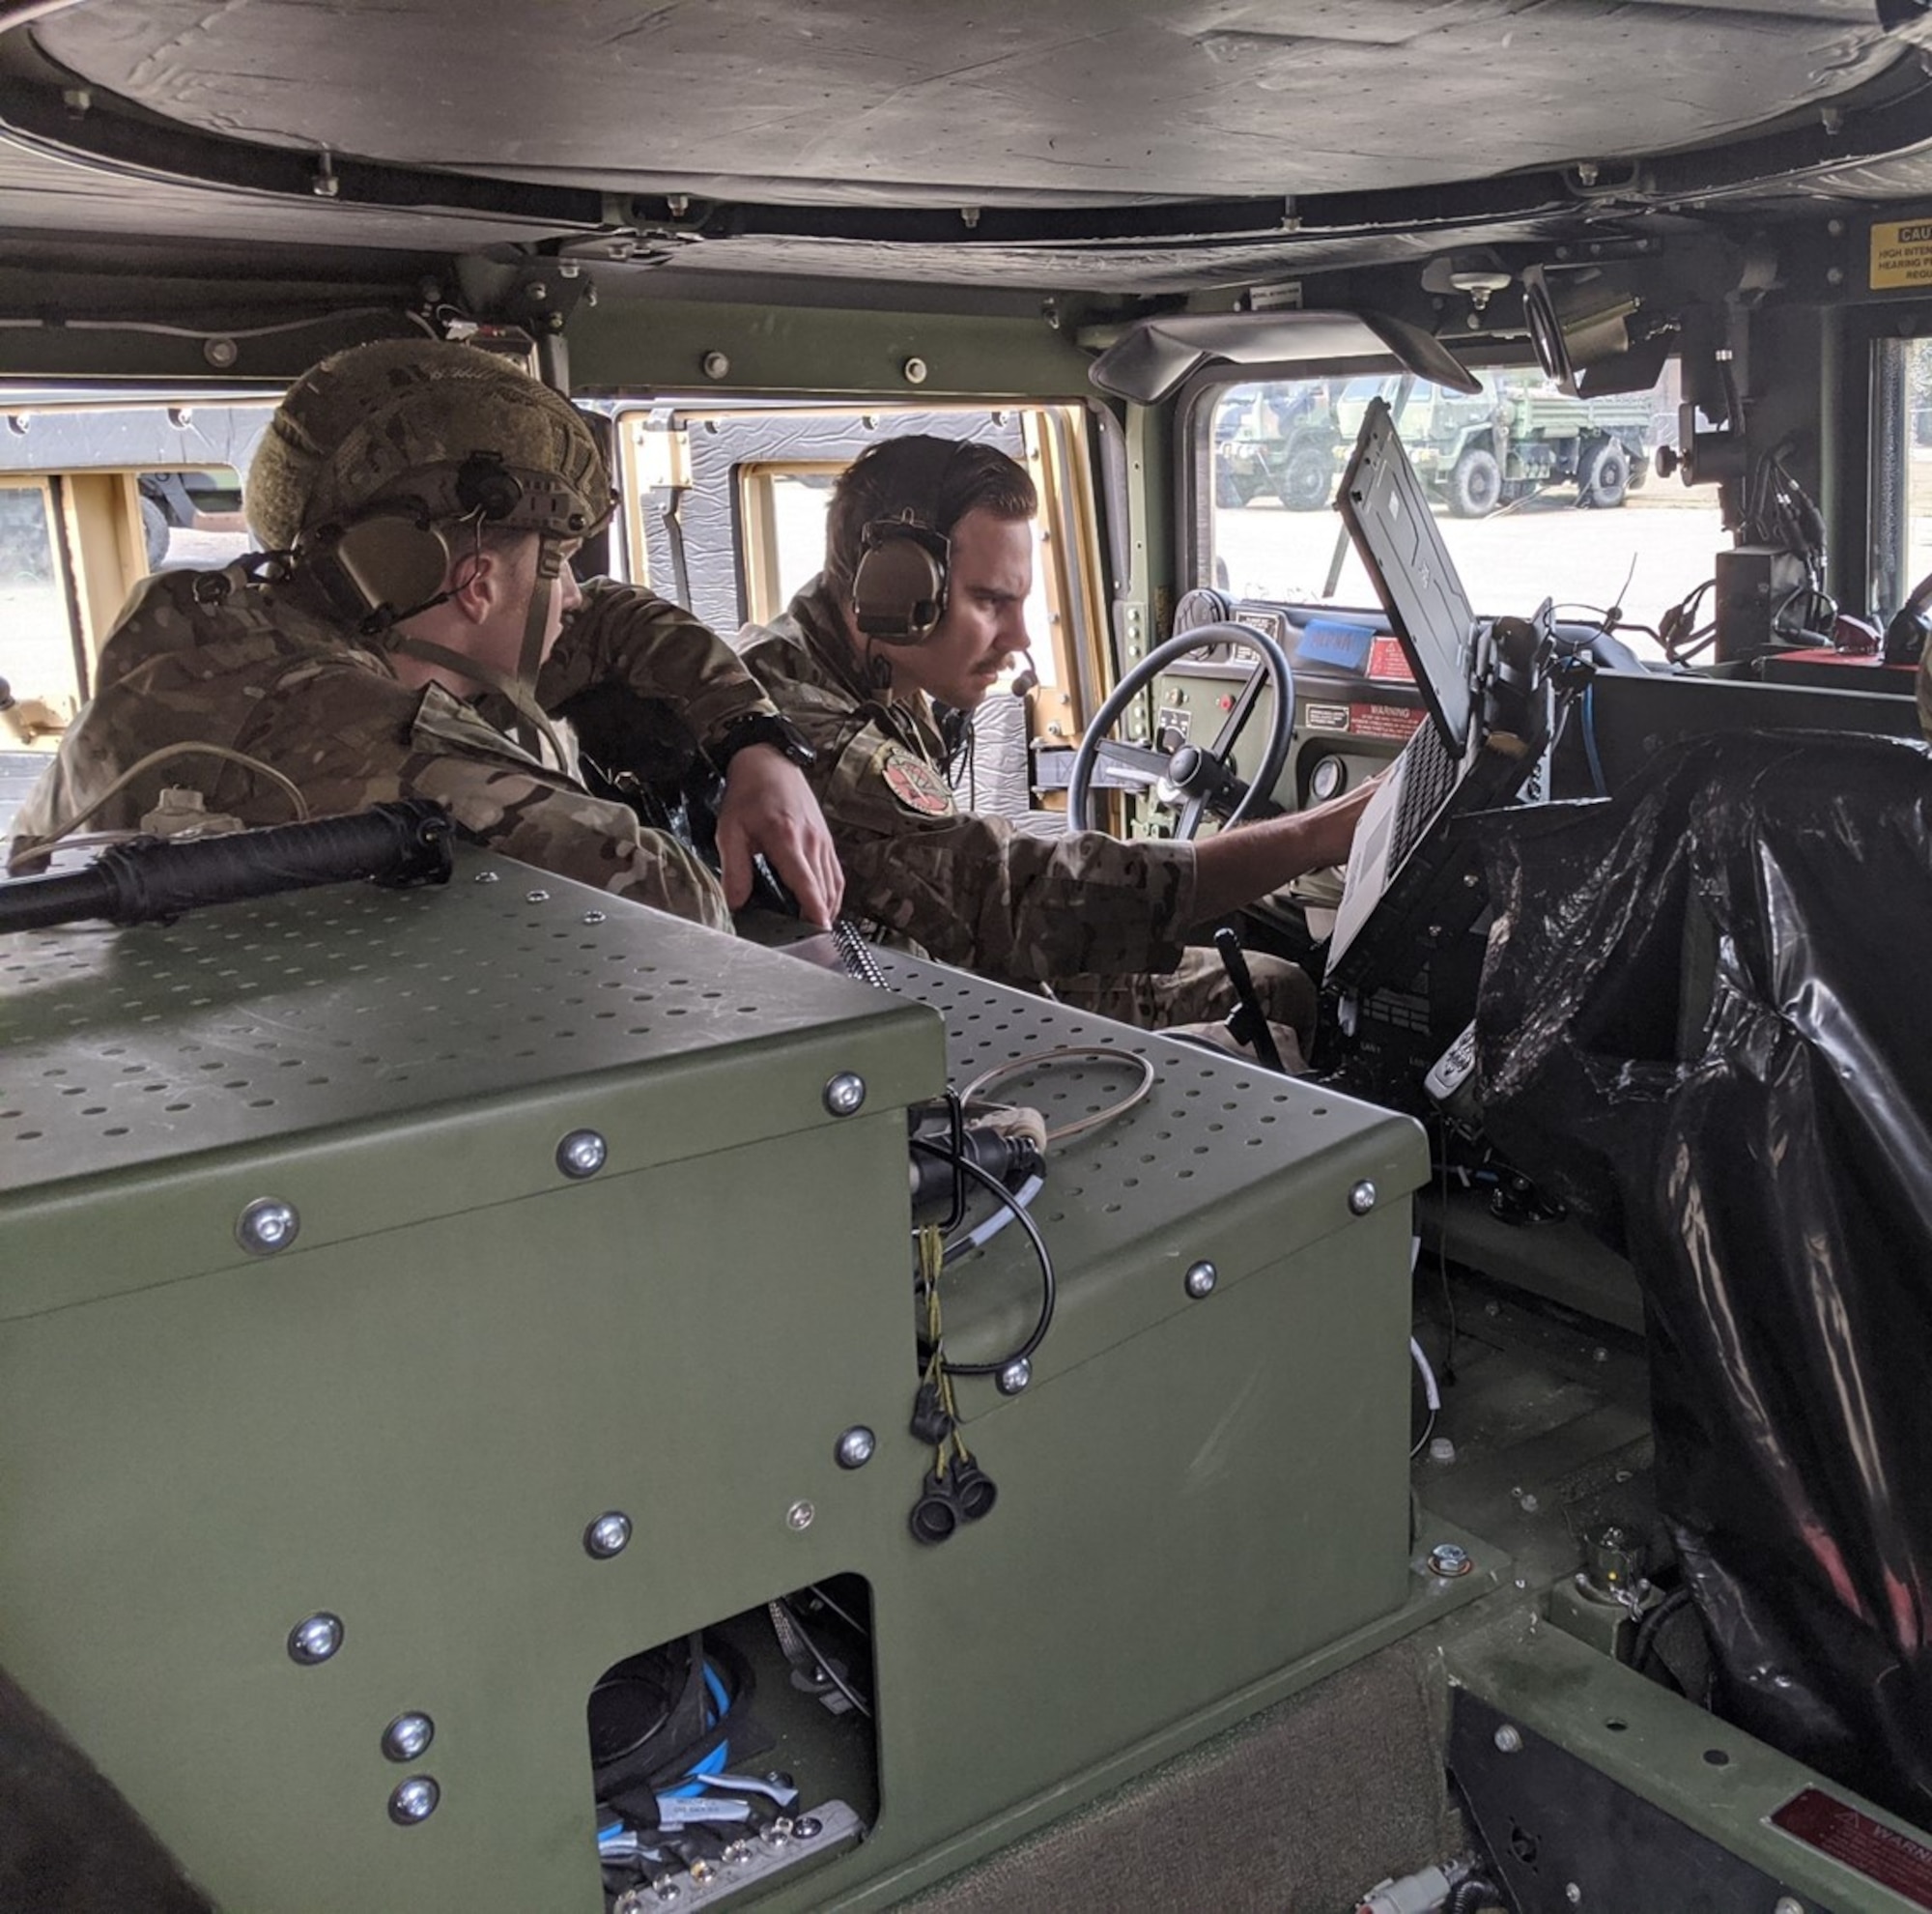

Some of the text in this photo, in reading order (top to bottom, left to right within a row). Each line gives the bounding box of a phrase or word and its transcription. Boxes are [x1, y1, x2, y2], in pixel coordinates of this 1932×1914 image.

[1901, 227, 1932, 242] CAU
[1879, 248, 1902, 259] HIGH
[1878, 258, 1921, 271] HEARING
[1370, 704, 1409, 719] WARNING
